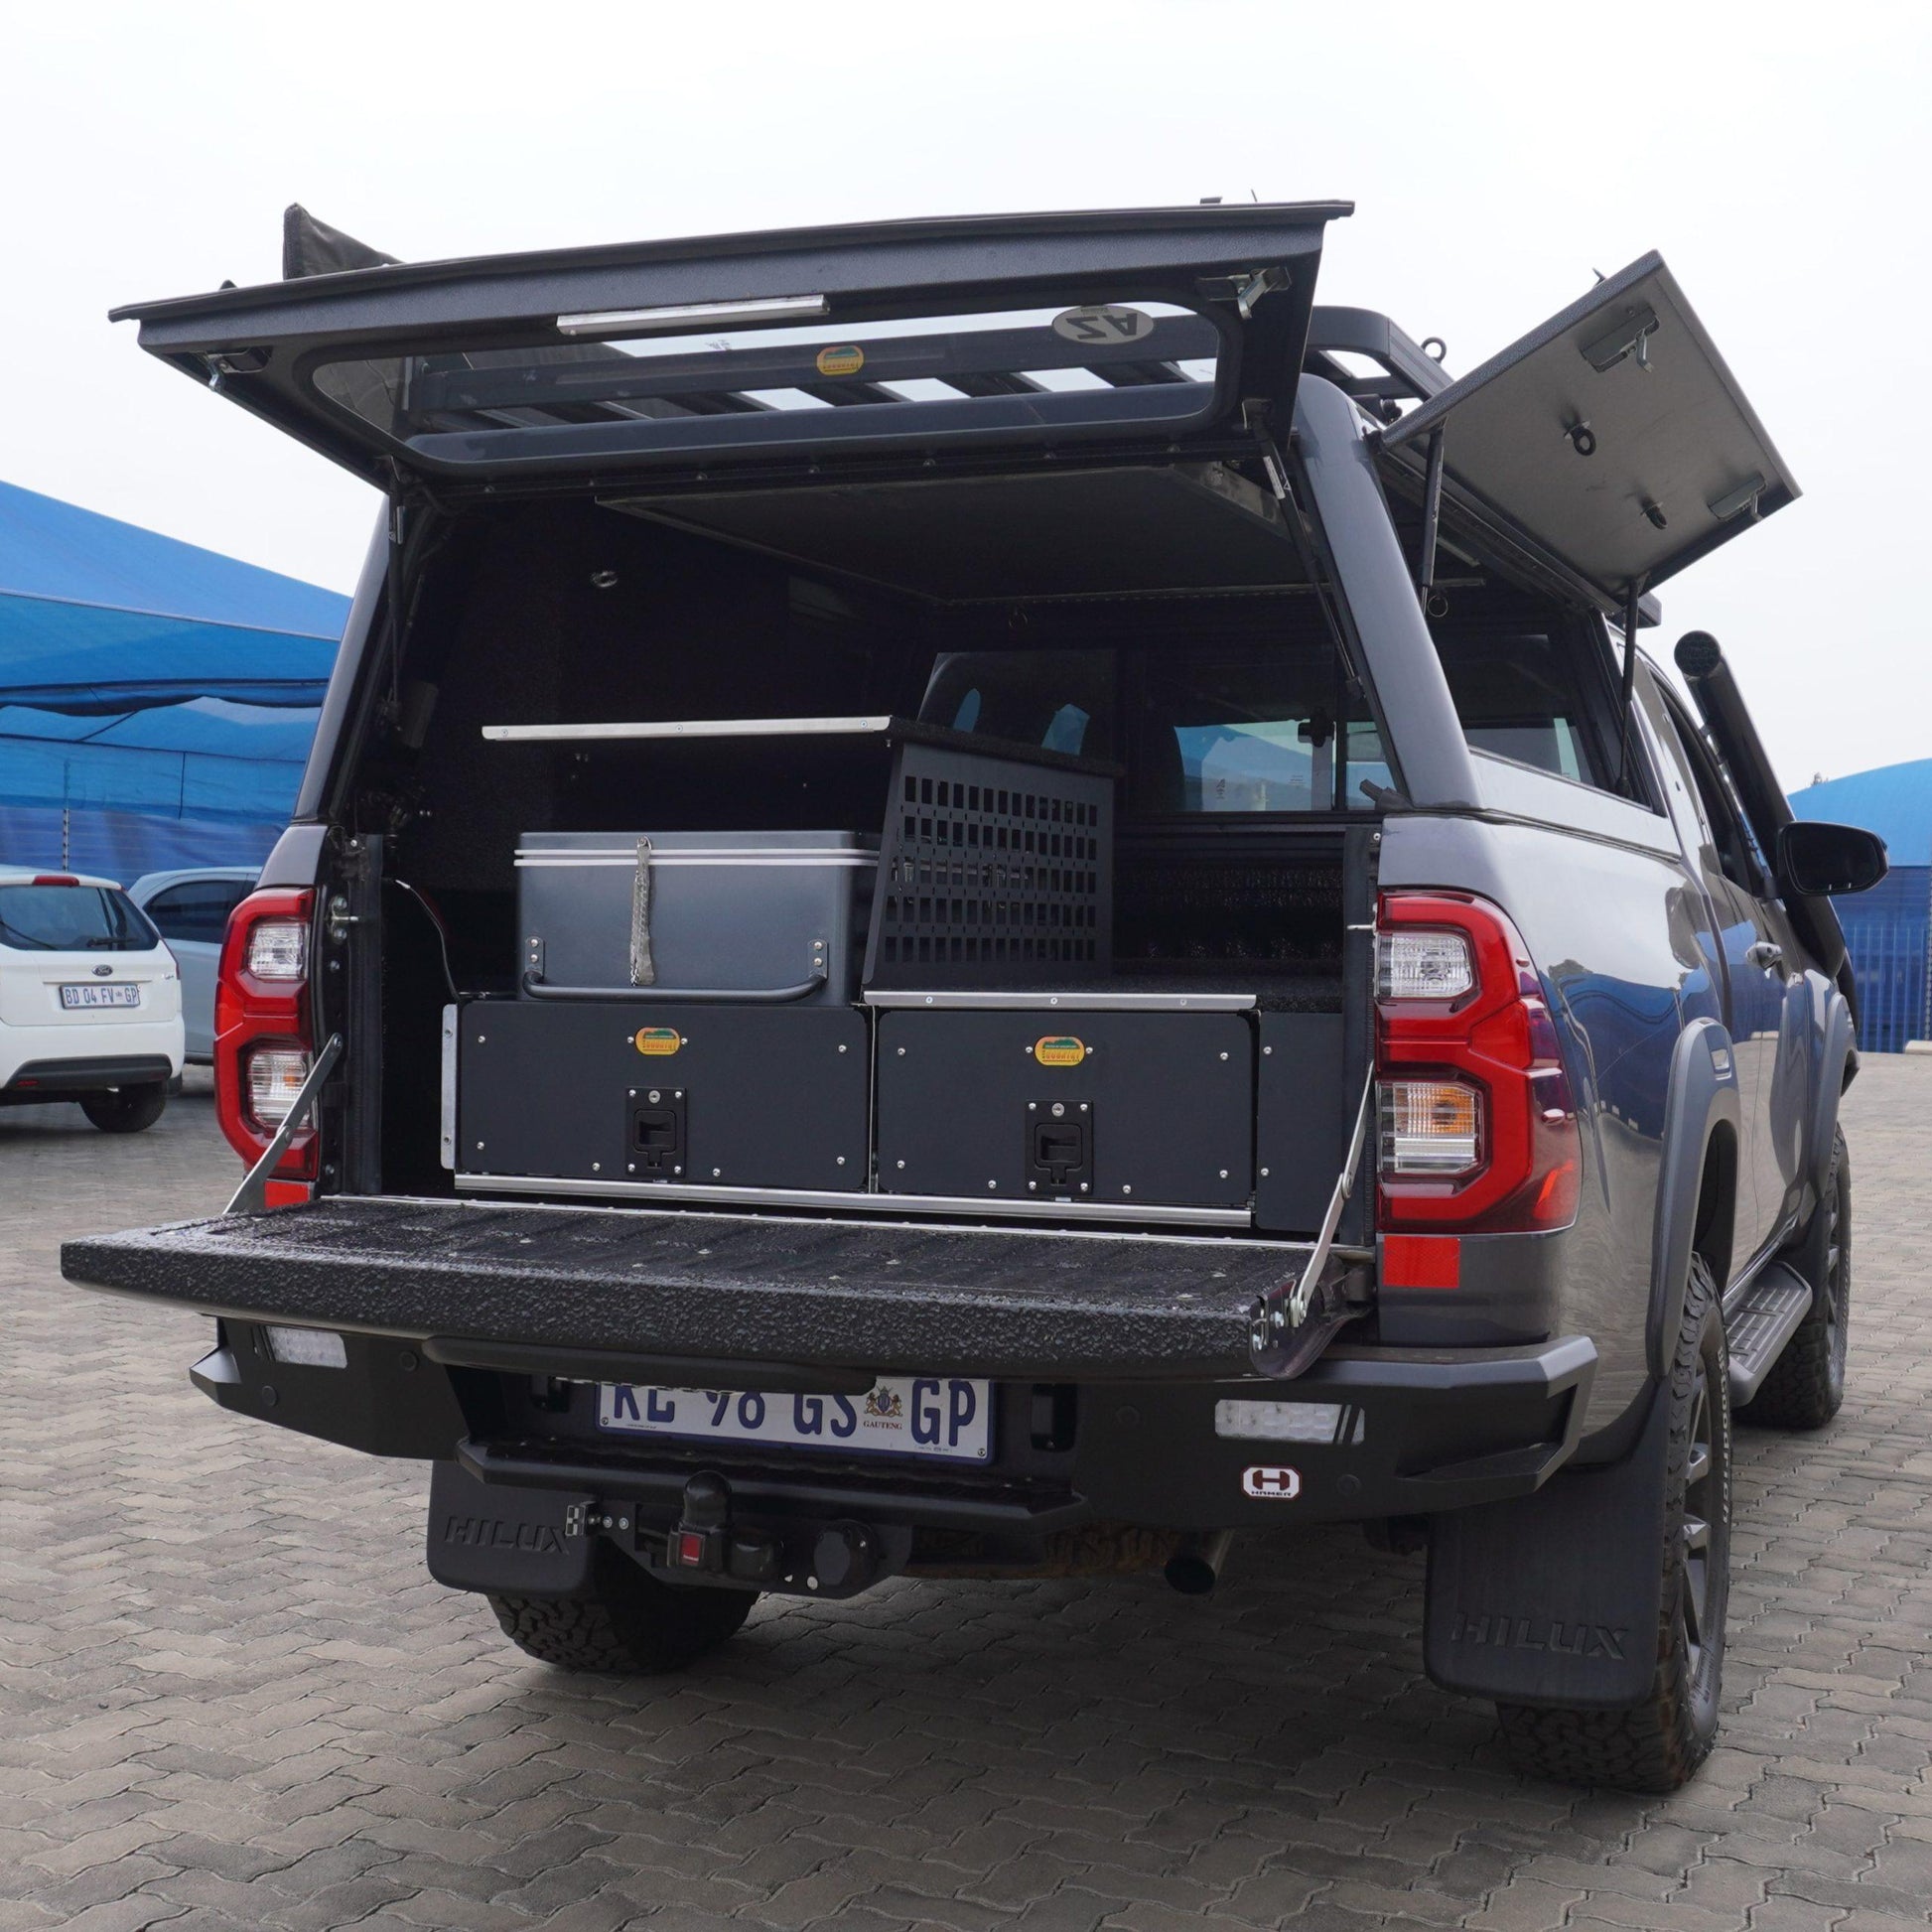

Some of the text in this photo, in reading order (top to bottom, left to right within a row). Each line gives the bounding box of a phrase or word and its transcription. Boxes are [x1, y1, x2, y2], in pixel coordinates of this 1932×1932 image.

[65, 987, 137, 1005] BD 04 FV GP
[793, 1392, 857, 1438] GS
[910, 1378, 976, 1447] GP
[863, 1420, 902, 1431] GAUTENG
[444, 1516, 570, 1556] HILUX
[1450, 1610, 1629, 1660] HILUX
